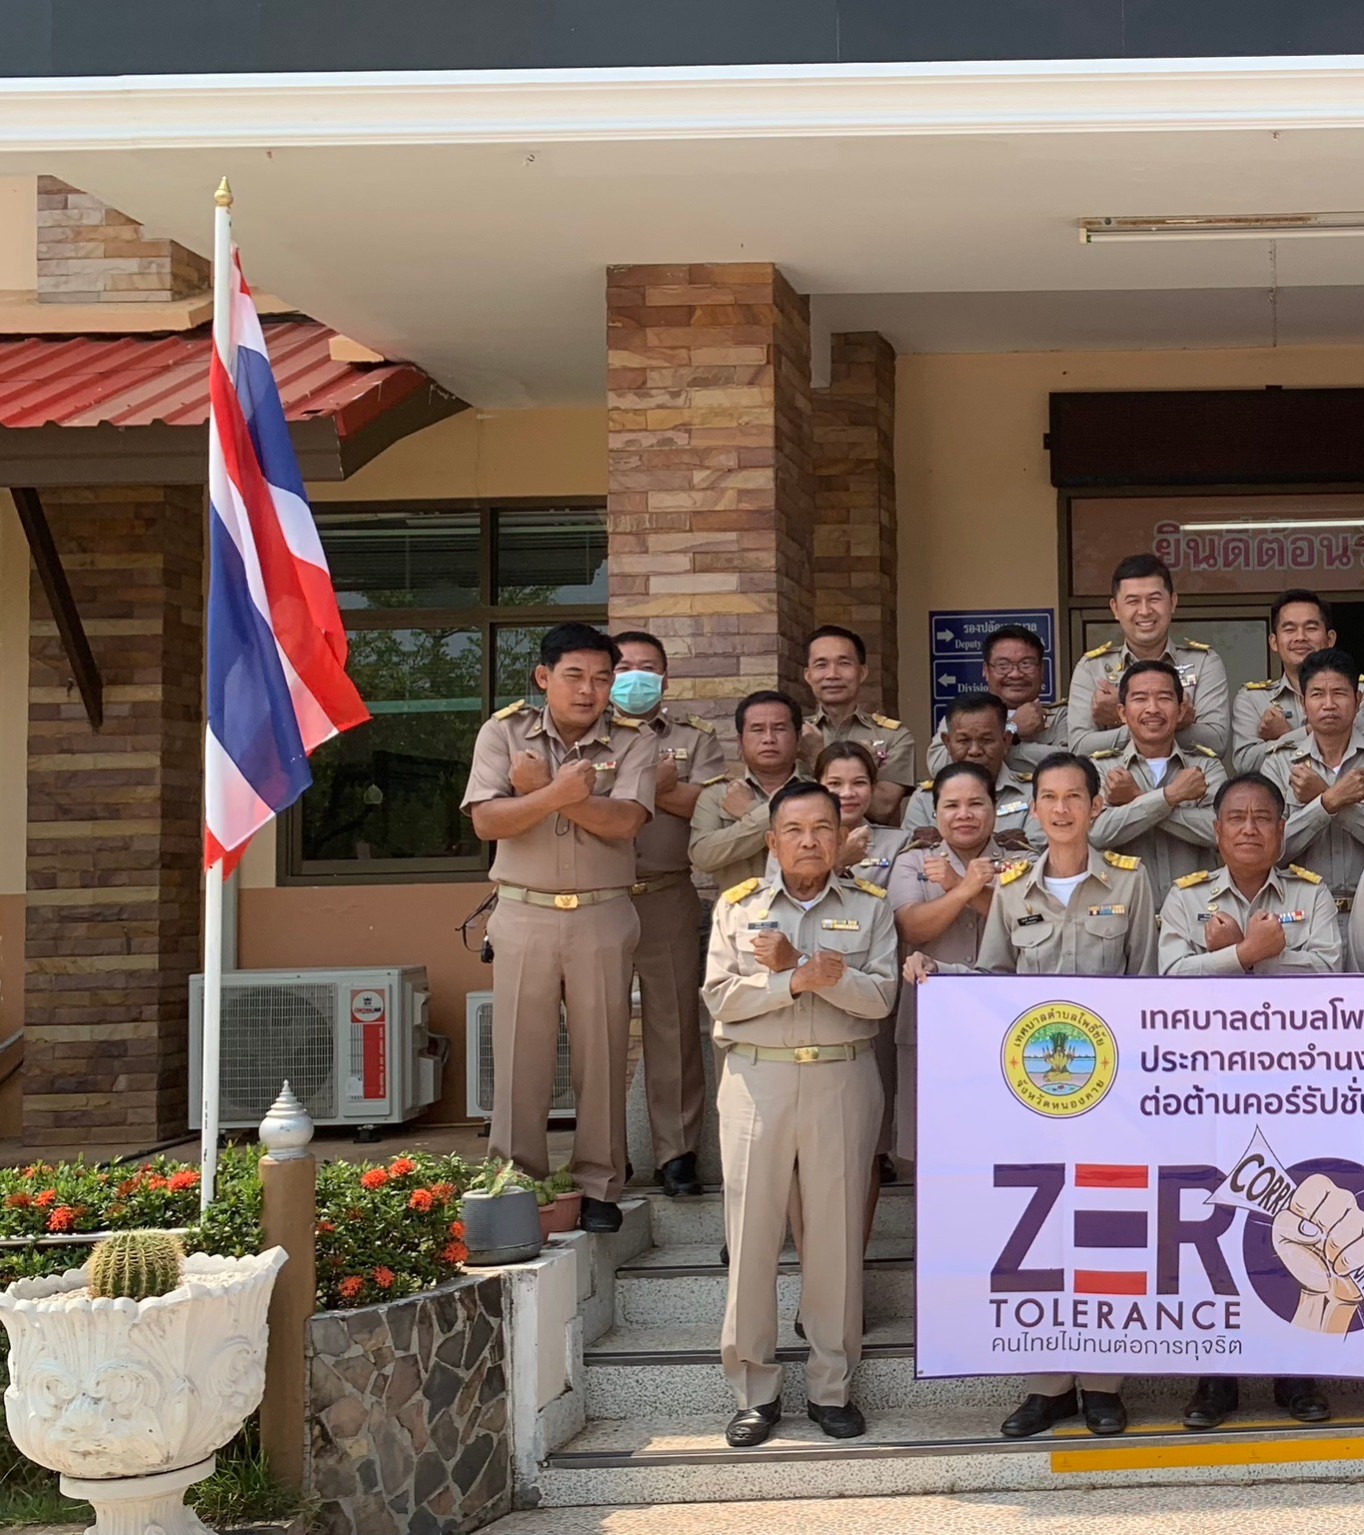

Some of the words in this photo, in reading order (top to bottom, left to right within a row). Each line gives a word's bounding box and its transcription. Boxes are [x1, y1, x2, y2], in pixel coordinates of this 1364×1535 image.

[955, 640, 982, 650] Deputy
[957, 683, 989, 692] Divisio
[1013, 1008, 1107, 1048] เทศบาลตำบลโพธิ์ชัย
[1017, 1079, 1105, 1110] จังหวัดหนองคาย
[989, 1298, 1241, 1330] TOLERANCE
[992, 1331, 1243, 1361] คนไทยไม่ทนต่อการทุจริต
